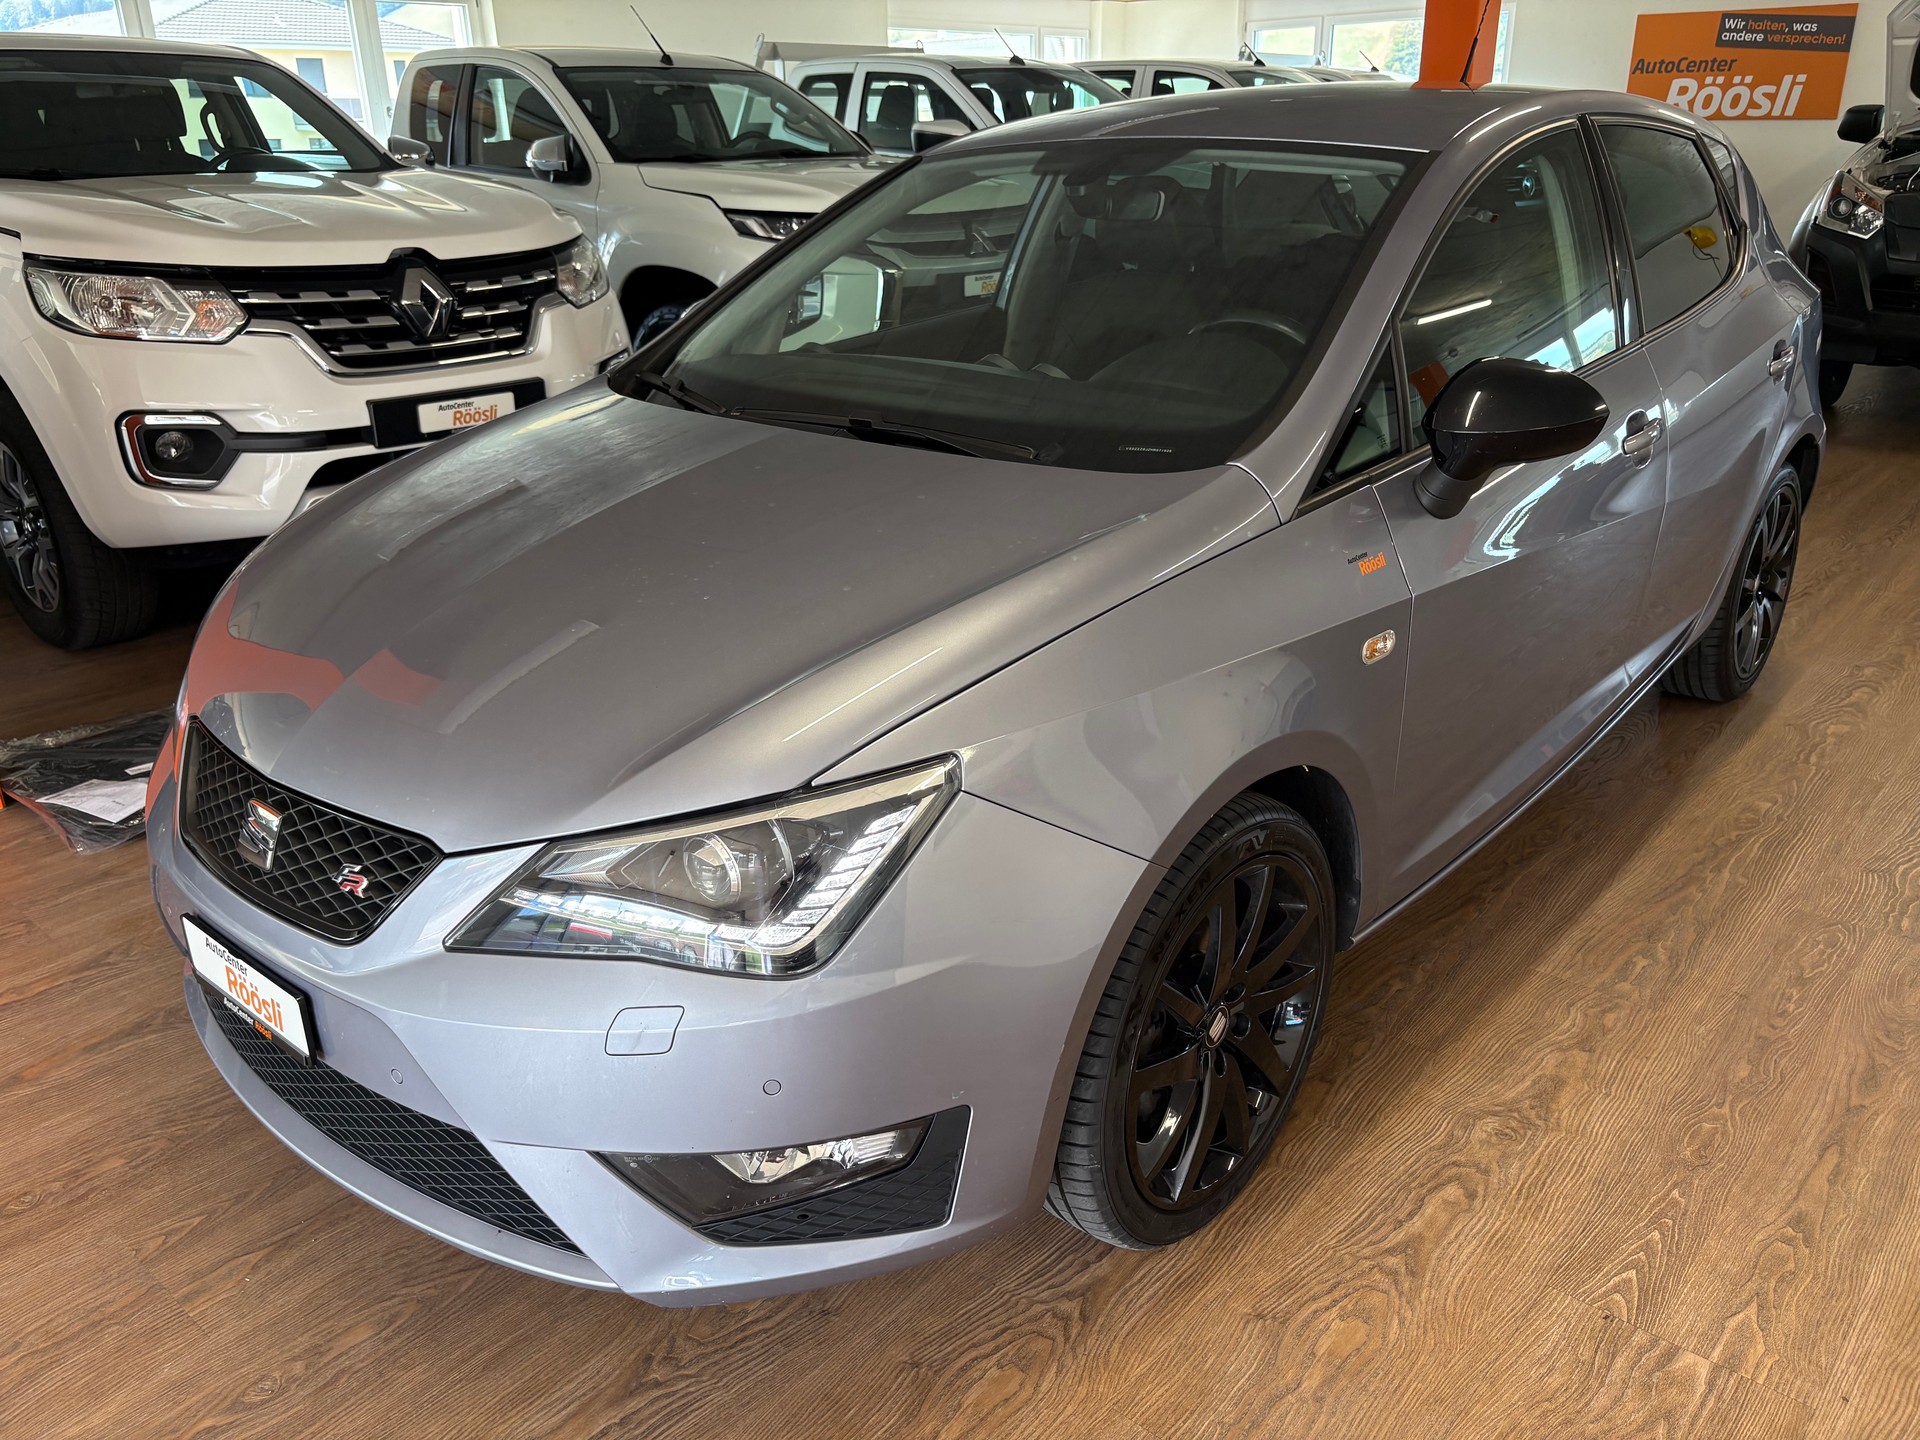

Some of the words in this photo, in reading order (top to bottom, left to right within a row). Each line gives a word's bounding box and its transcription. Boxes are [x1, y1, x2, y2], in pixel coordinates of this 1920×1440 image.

[1724, 18, 1745, 30] Wir
[1748, 19, 1789, 33] halten,
[1793, 23, 1818, 32] was
[1721, 31, 1764, 42] andere
[1767, 33, 1846, 45] versprechen!
[1632, 56, 1737, 75] AutoCenter
[1665, 74, 1807, 118] Röösli
[438, 401, 474, 412] AutoCenter
[453, 405, 498, 426] Röösli
[1358, 552, 1386, 576] Röösli
[205, 937, 248, 976] AutoCenter
[225, 964, 284, 1032] Röösli
